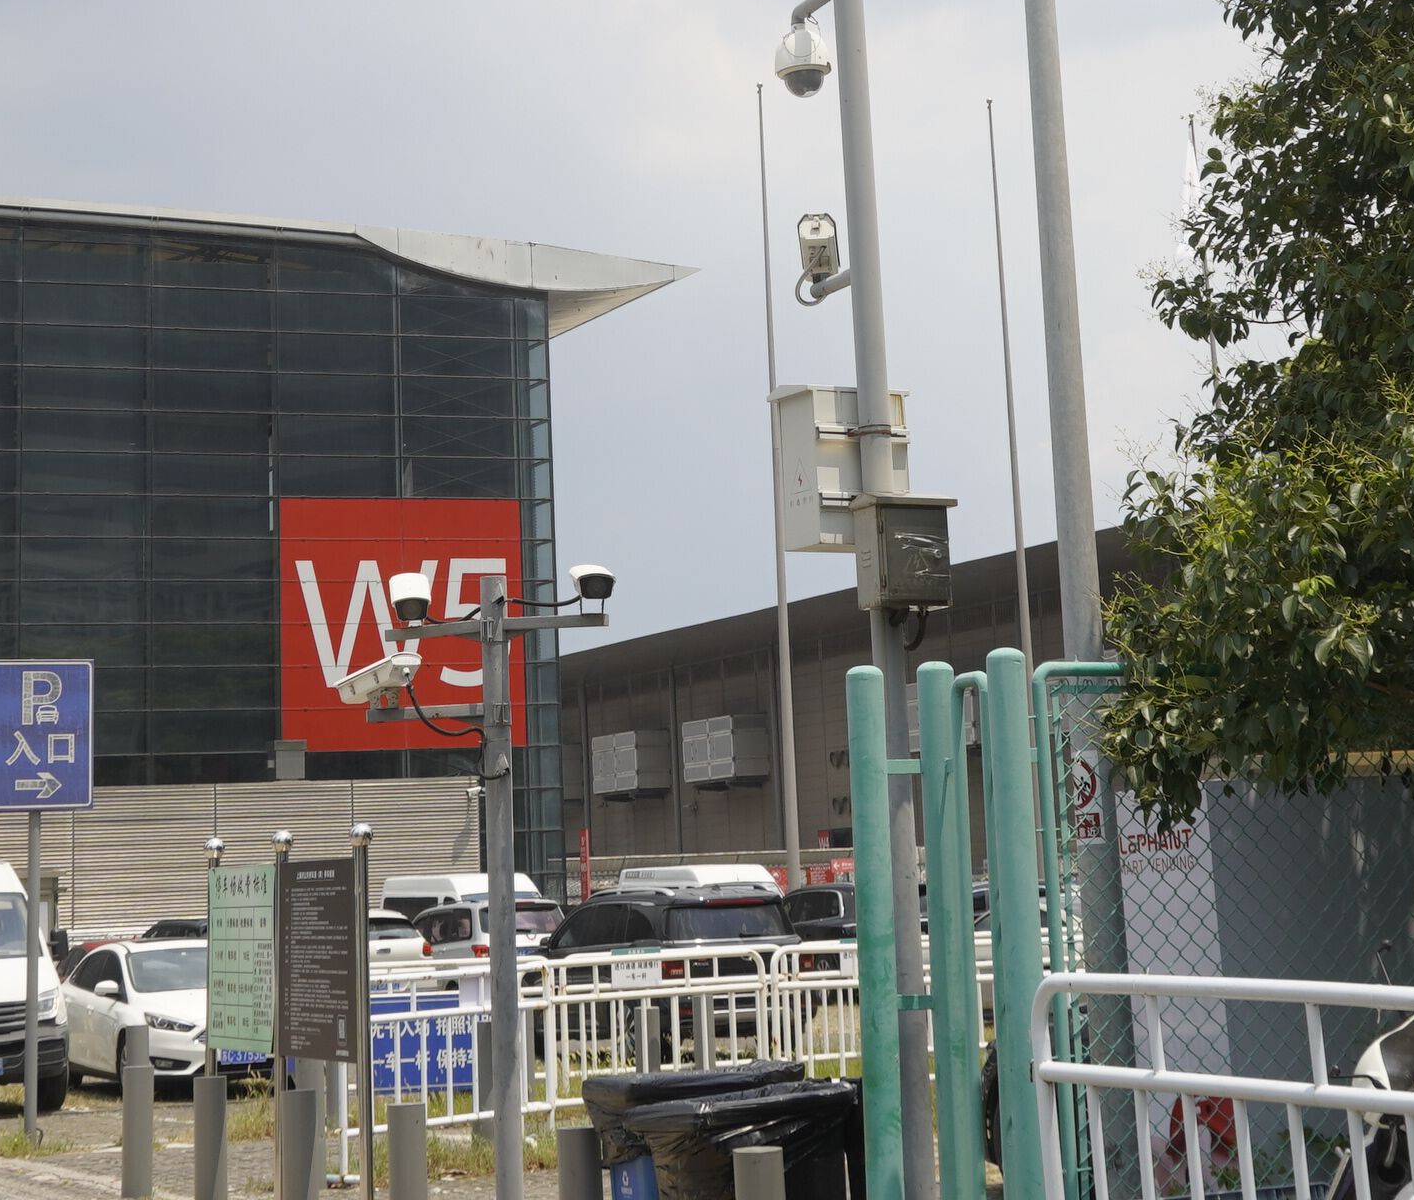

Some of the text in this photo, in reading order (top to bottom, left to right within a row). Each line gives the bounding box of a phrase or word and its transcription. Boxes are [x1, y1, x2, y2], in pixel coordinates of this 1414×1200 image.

[295, 558, 510, 688] W5
[22, 671, 63, 726] P
[5, 730, 75, 766] 入口
